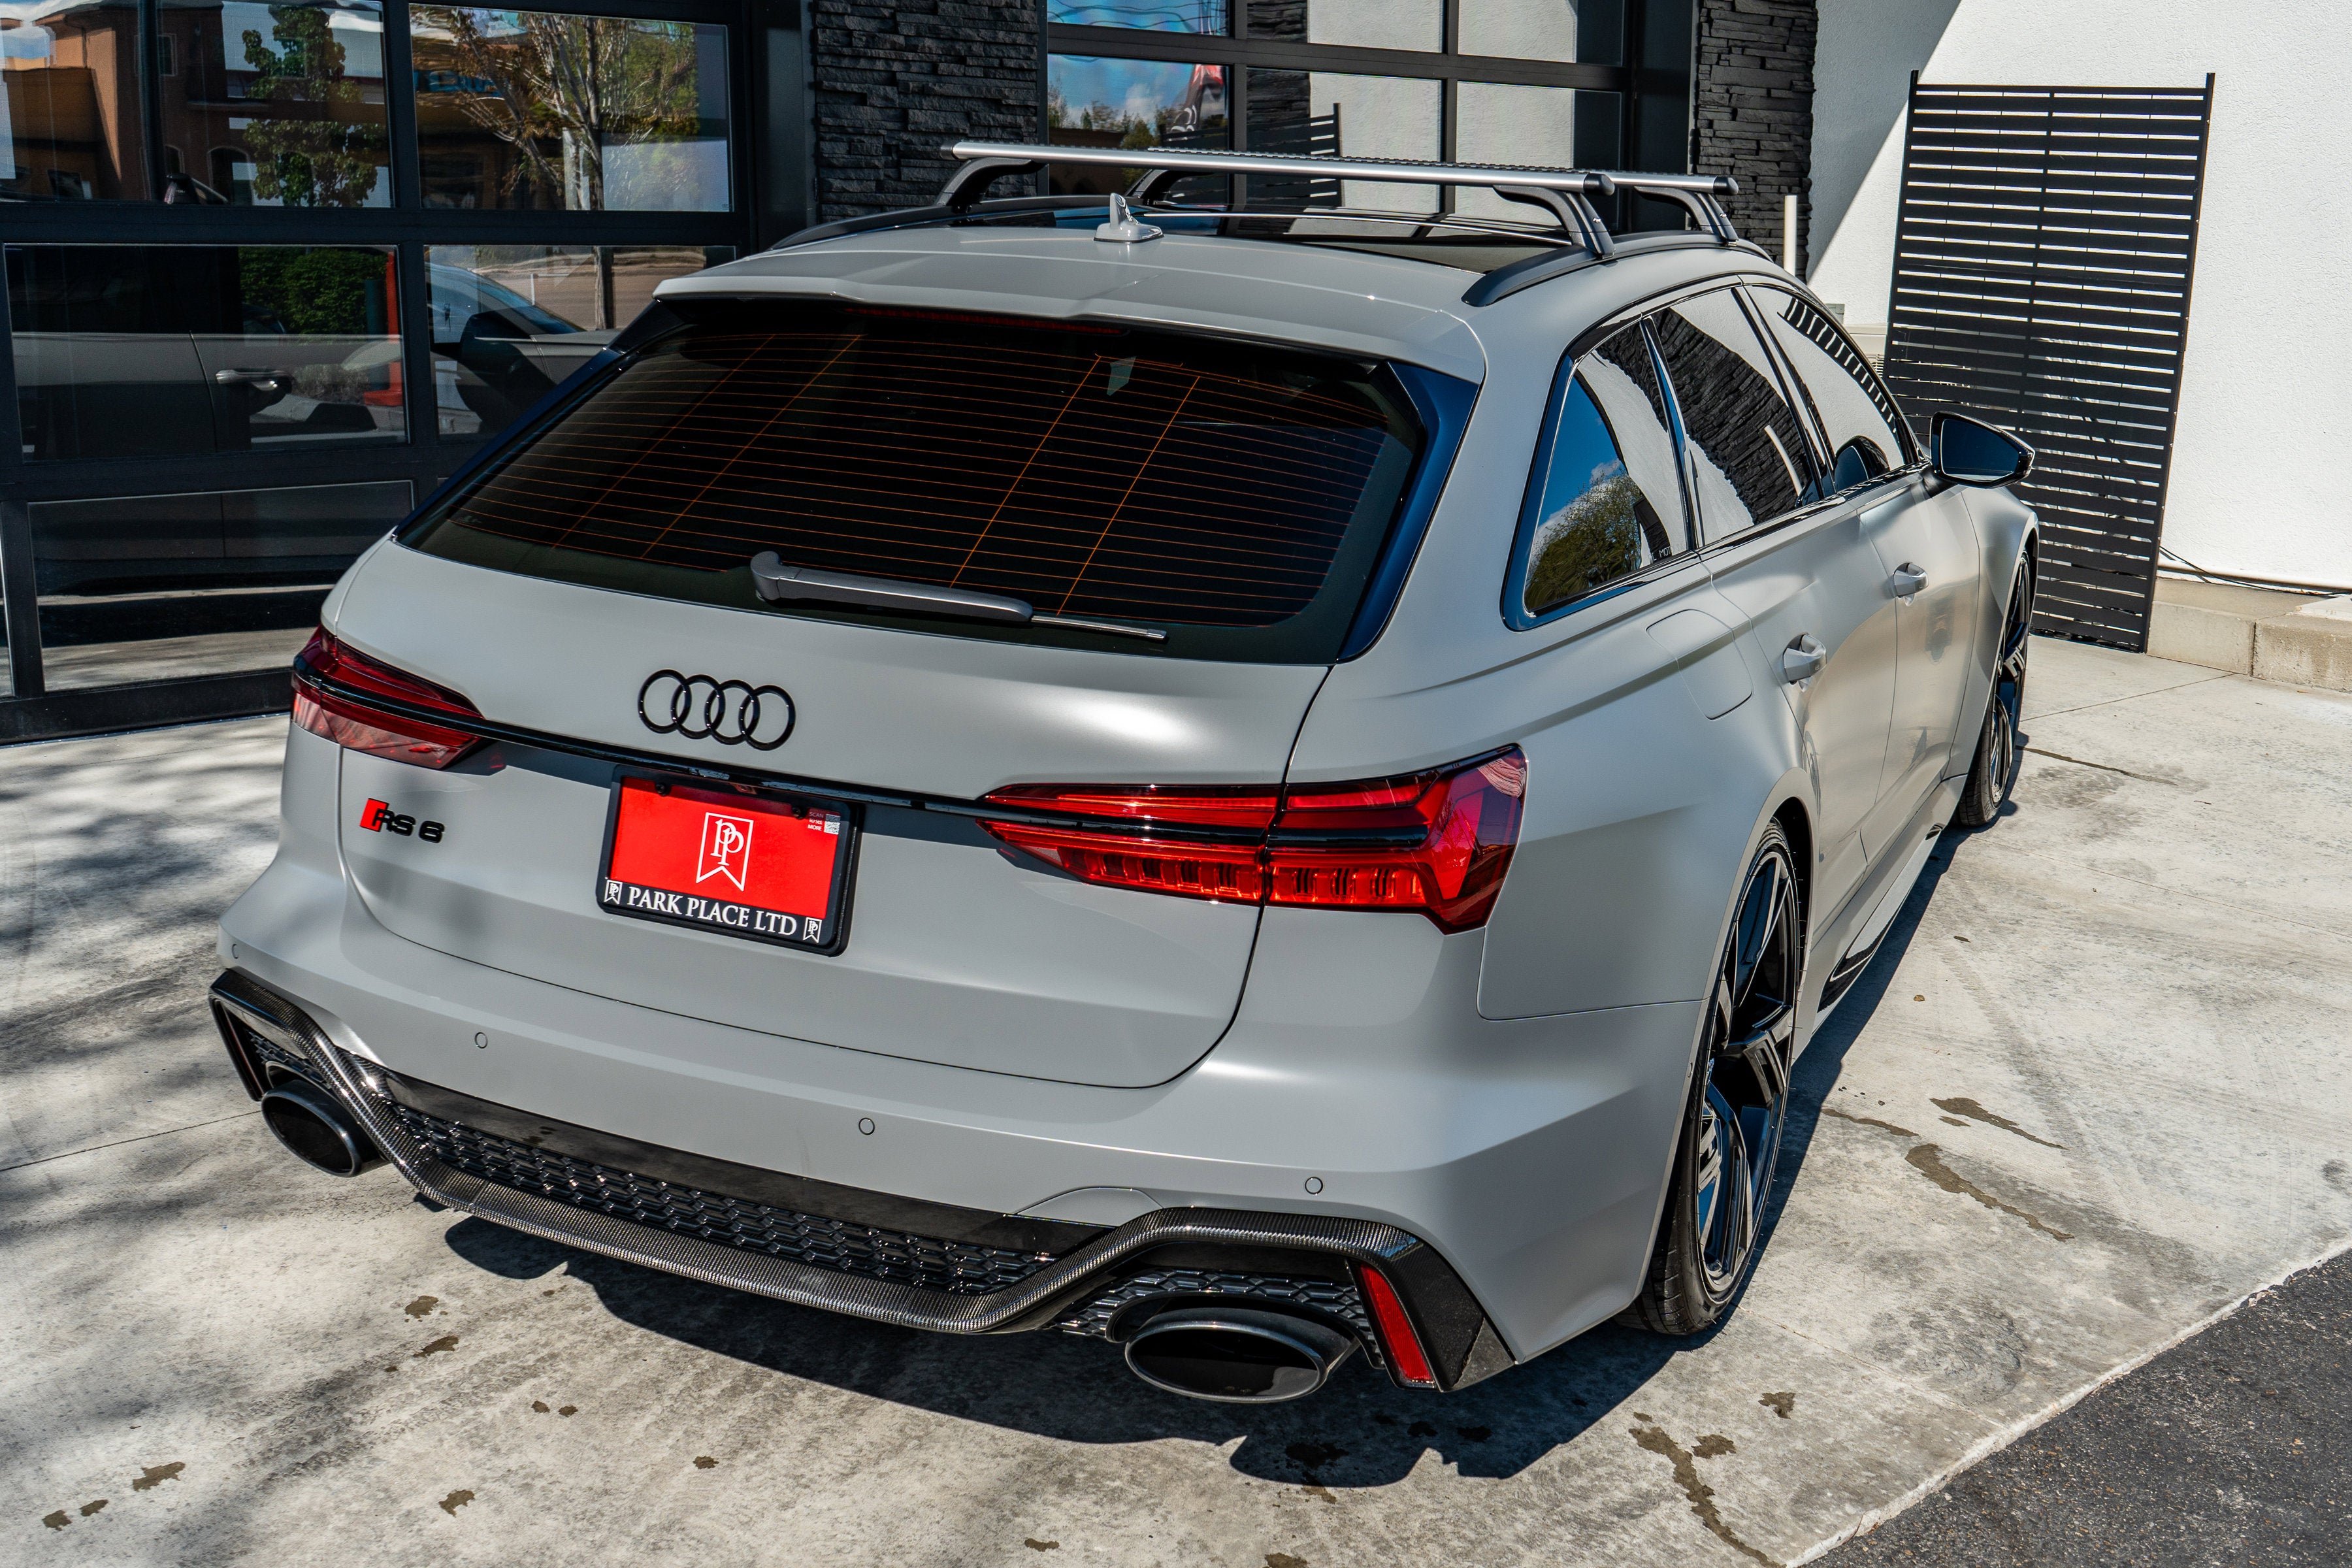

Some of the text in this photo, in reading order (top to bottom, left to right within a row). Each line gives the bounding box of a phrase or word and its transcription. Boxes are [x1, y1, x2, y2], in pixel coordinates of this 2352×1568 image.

[371, 808, 446, 843] RS 6
[627, 886, 798, 936] PARK PLACE LTD
